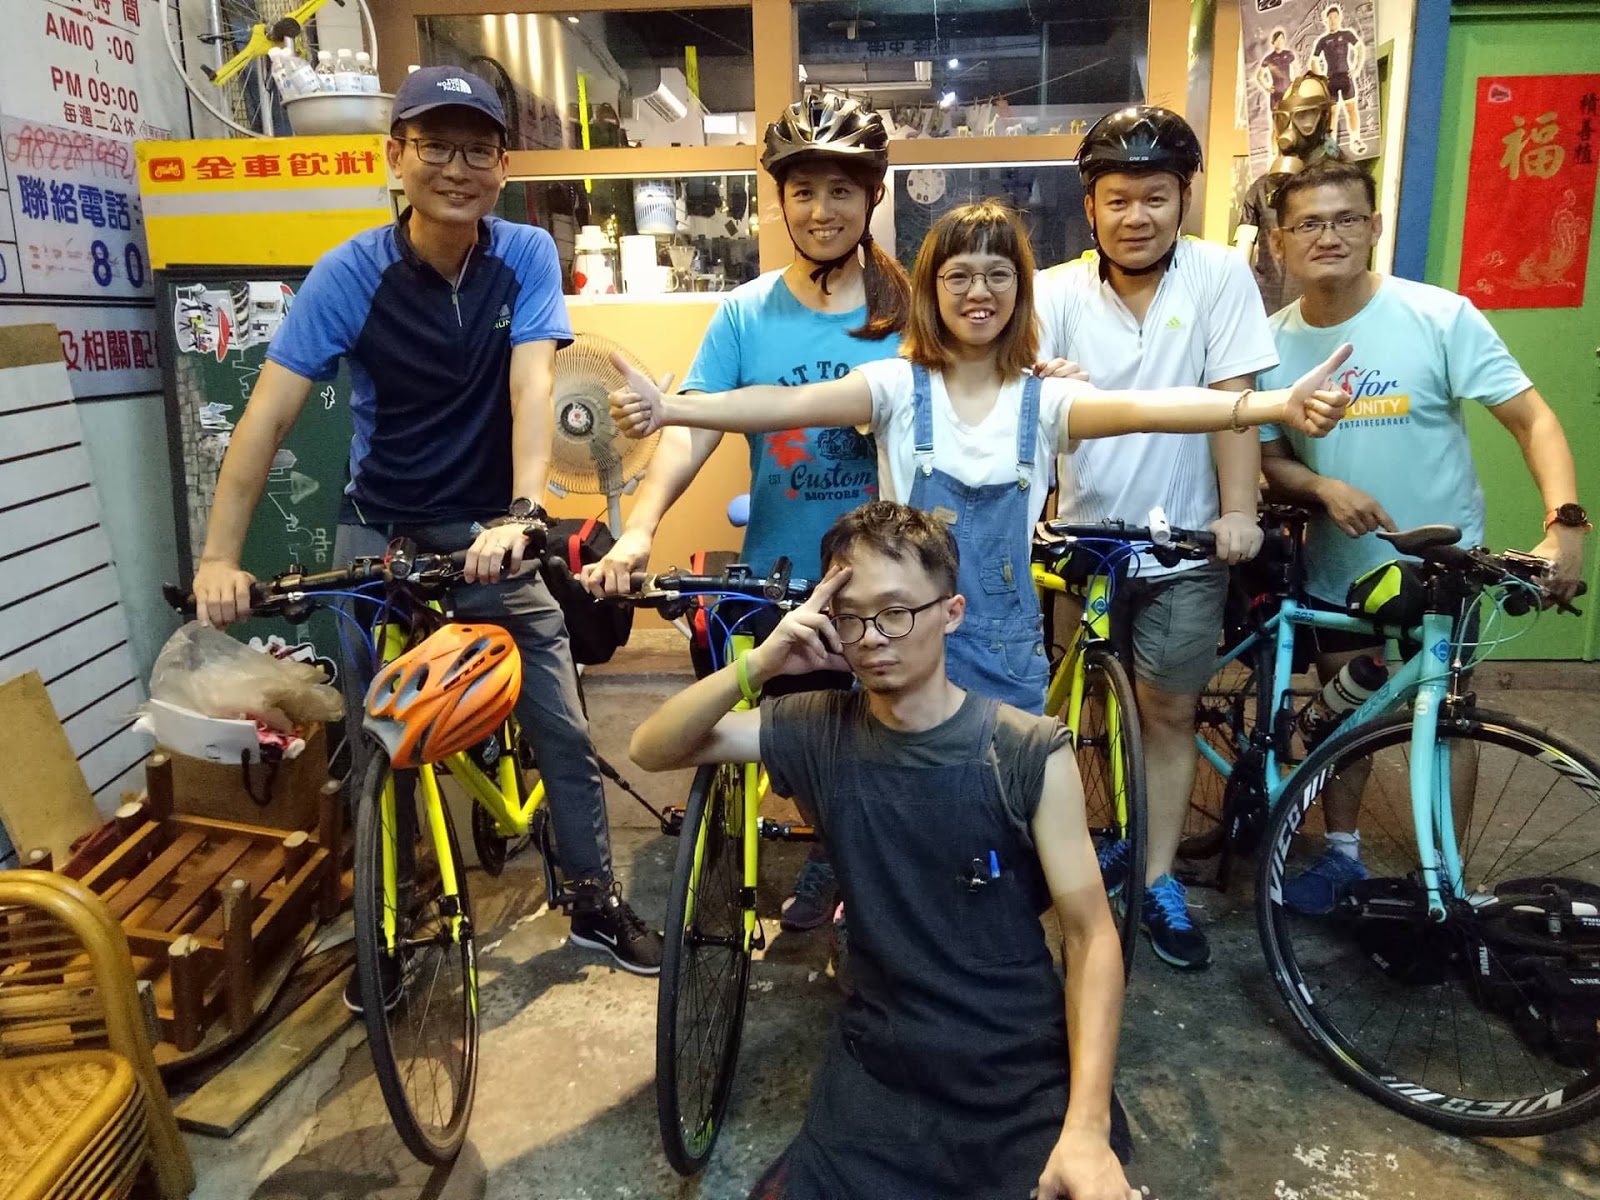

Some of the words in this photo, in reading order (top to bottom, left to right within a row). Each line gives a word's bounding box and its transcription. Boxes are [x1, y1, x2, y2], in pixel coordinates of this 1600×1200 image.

[51, 66, 82, 98] PM
[88, 77, 139, 113] 09:00
[1500, 111, 1566, 180] 福
[191, 151, 375, 180] 金車飲料
[58, 329, 159, 372] 及相關配
[1347, 370, 1399, 408] for
[1351, 398, 1401, 416] UNITY
[790, 463, 872, 490] Custom
[804, 489, 860, 501] MOTORS
